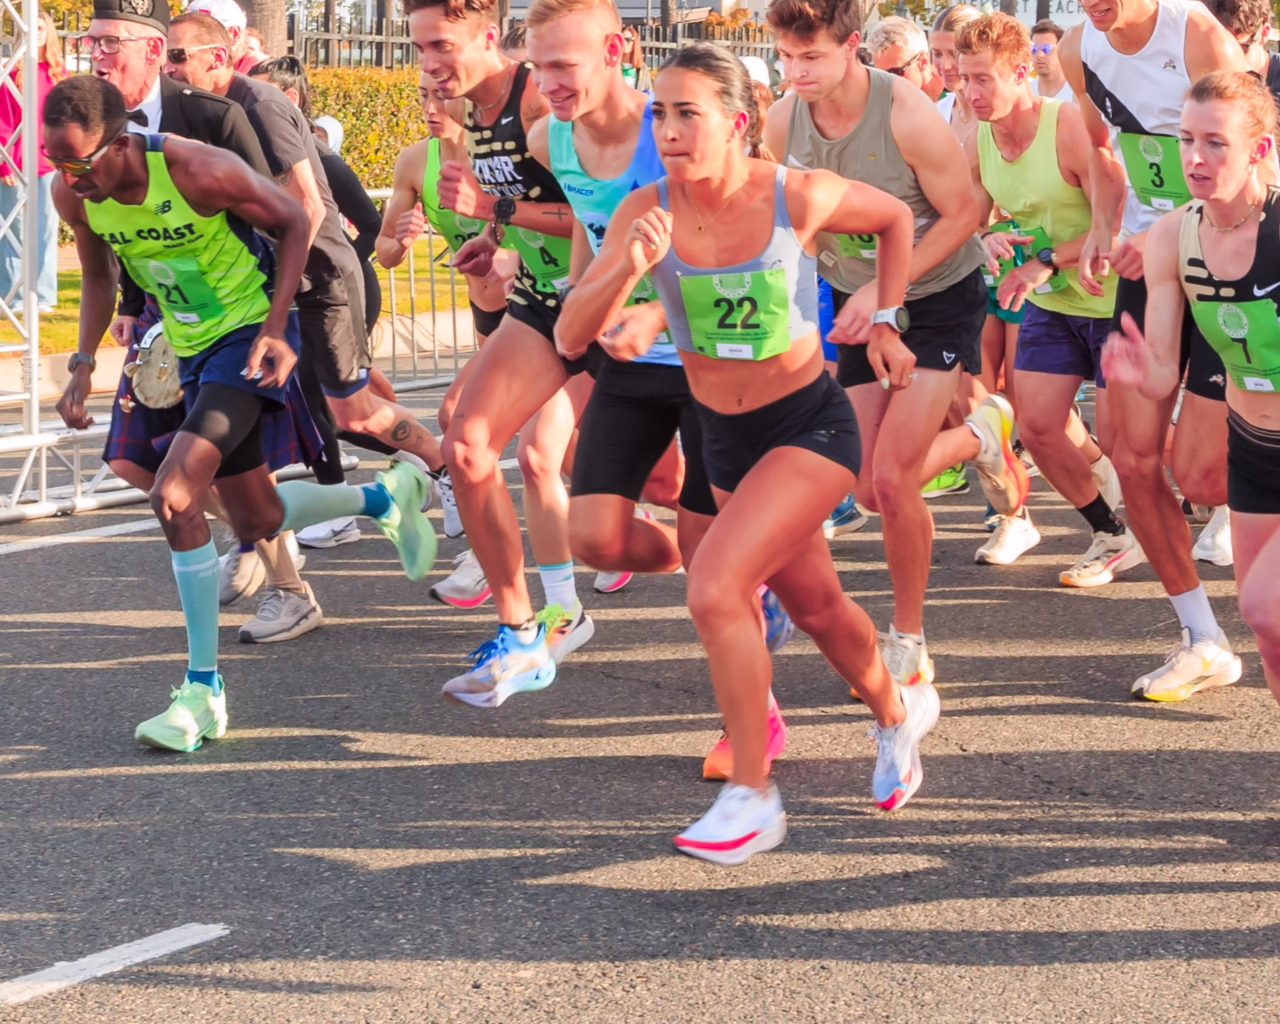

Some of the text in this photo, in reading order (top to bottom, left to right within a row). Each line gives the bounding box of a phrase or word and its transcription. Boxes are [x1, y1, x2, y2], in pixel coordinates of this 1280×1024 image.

[1035, 0, 1085, 14] EACH
[1149, 162, 1165, 188] 3
[136, 223, 196, 242] COAST
[539, 247, 559, 268] 4
[157, 282, 190, 305] 21
[713, 296, 760, 329] 22
